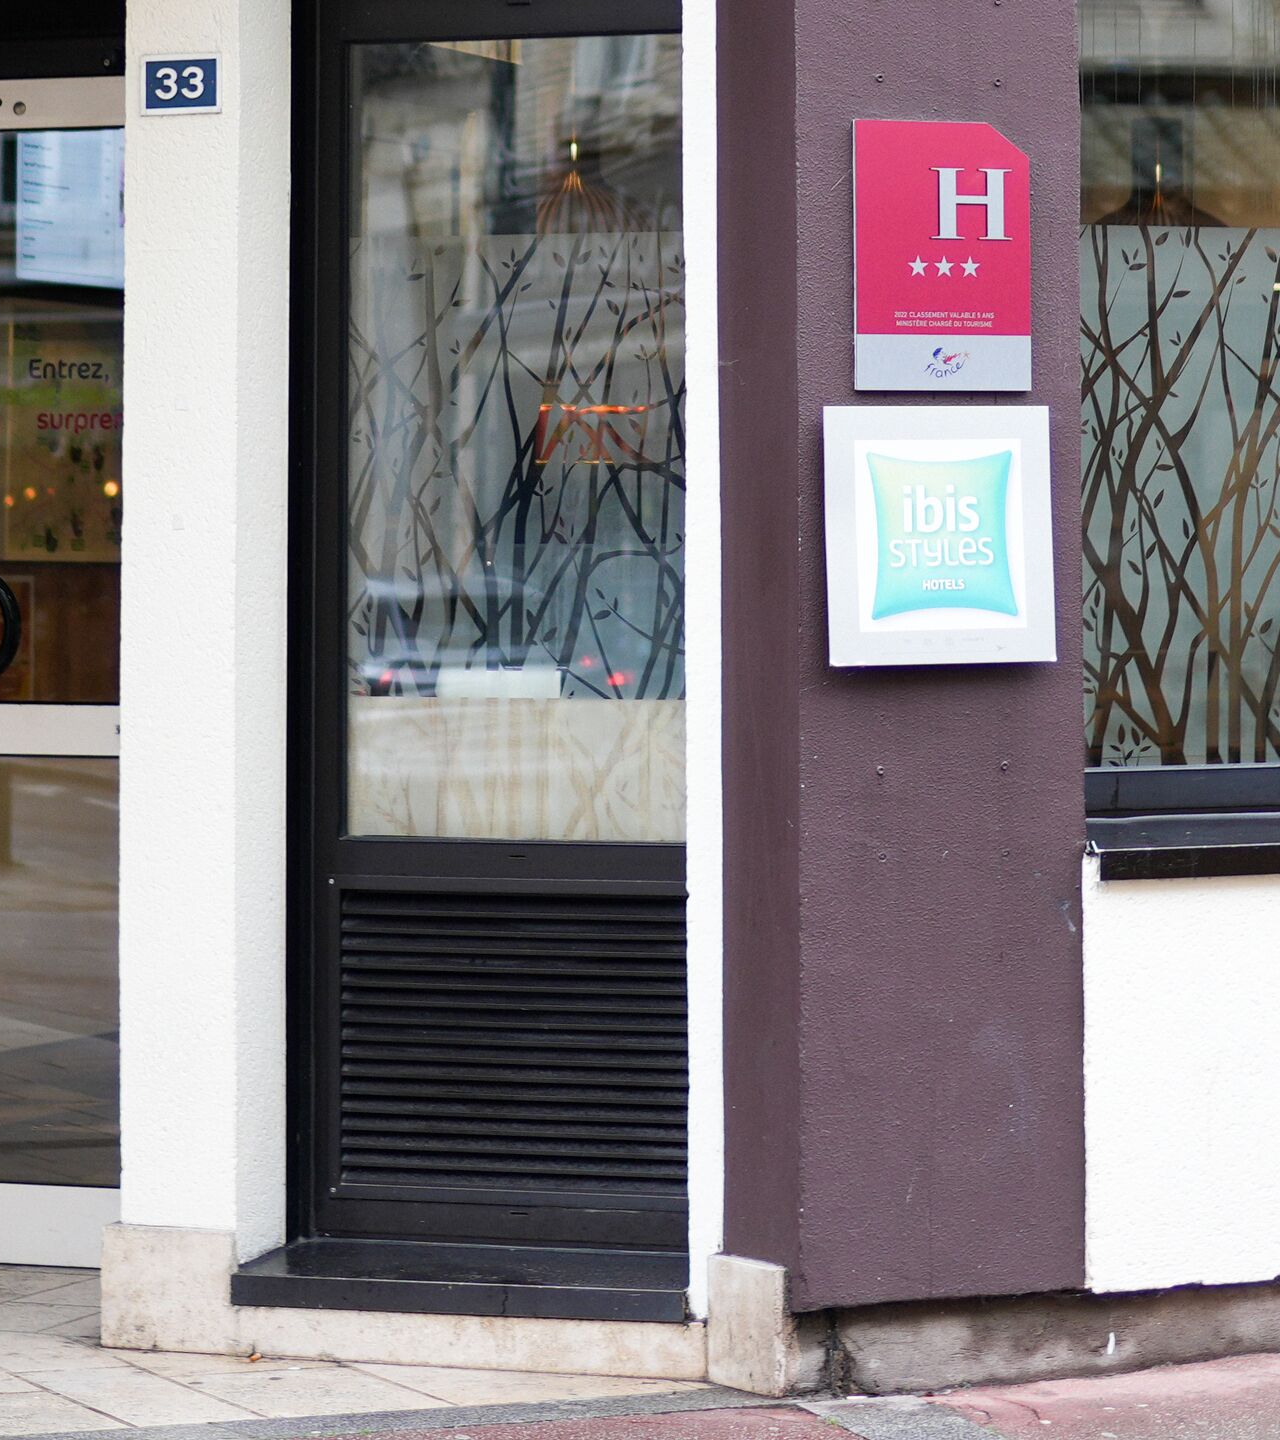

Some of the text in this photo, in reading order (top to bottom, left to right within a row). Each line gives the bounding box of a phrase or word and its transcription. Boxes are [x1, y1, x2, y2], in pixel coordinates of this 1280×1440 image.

[154, 65, 206, 101] 33
[929, 167, 1013, 241] H
[909, 311, 949, 319] CLASSEMENT
[950, 311, 976, 319] VALABLE
[28, 358, 110, 382] Entrez,
[901, 484, 980, 533] ibis
[922, 578, 966, 591] HOTELS
